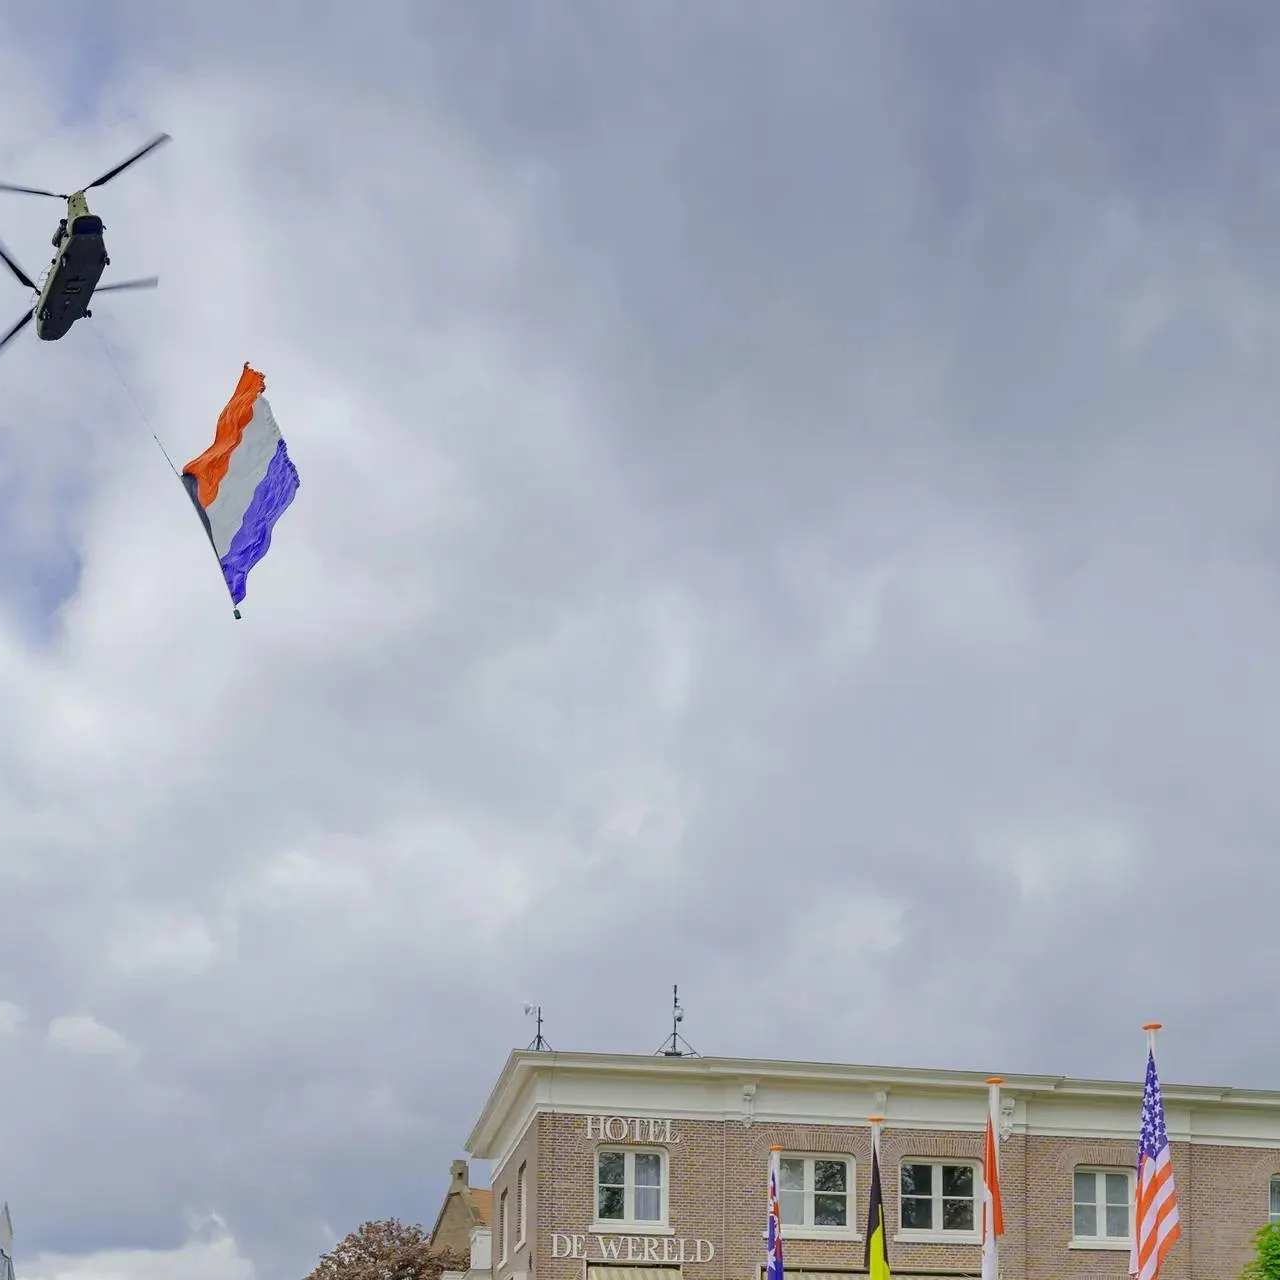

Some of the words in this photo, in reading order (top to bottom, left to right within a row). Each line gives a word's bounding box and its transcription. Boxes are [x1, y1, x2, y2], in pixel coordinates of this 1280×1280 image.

[586, 1115, 680, 1143] HOTEL
[550, 1233, 588, 1259] DE
[596, 1235, 715, 1263] WERELD
